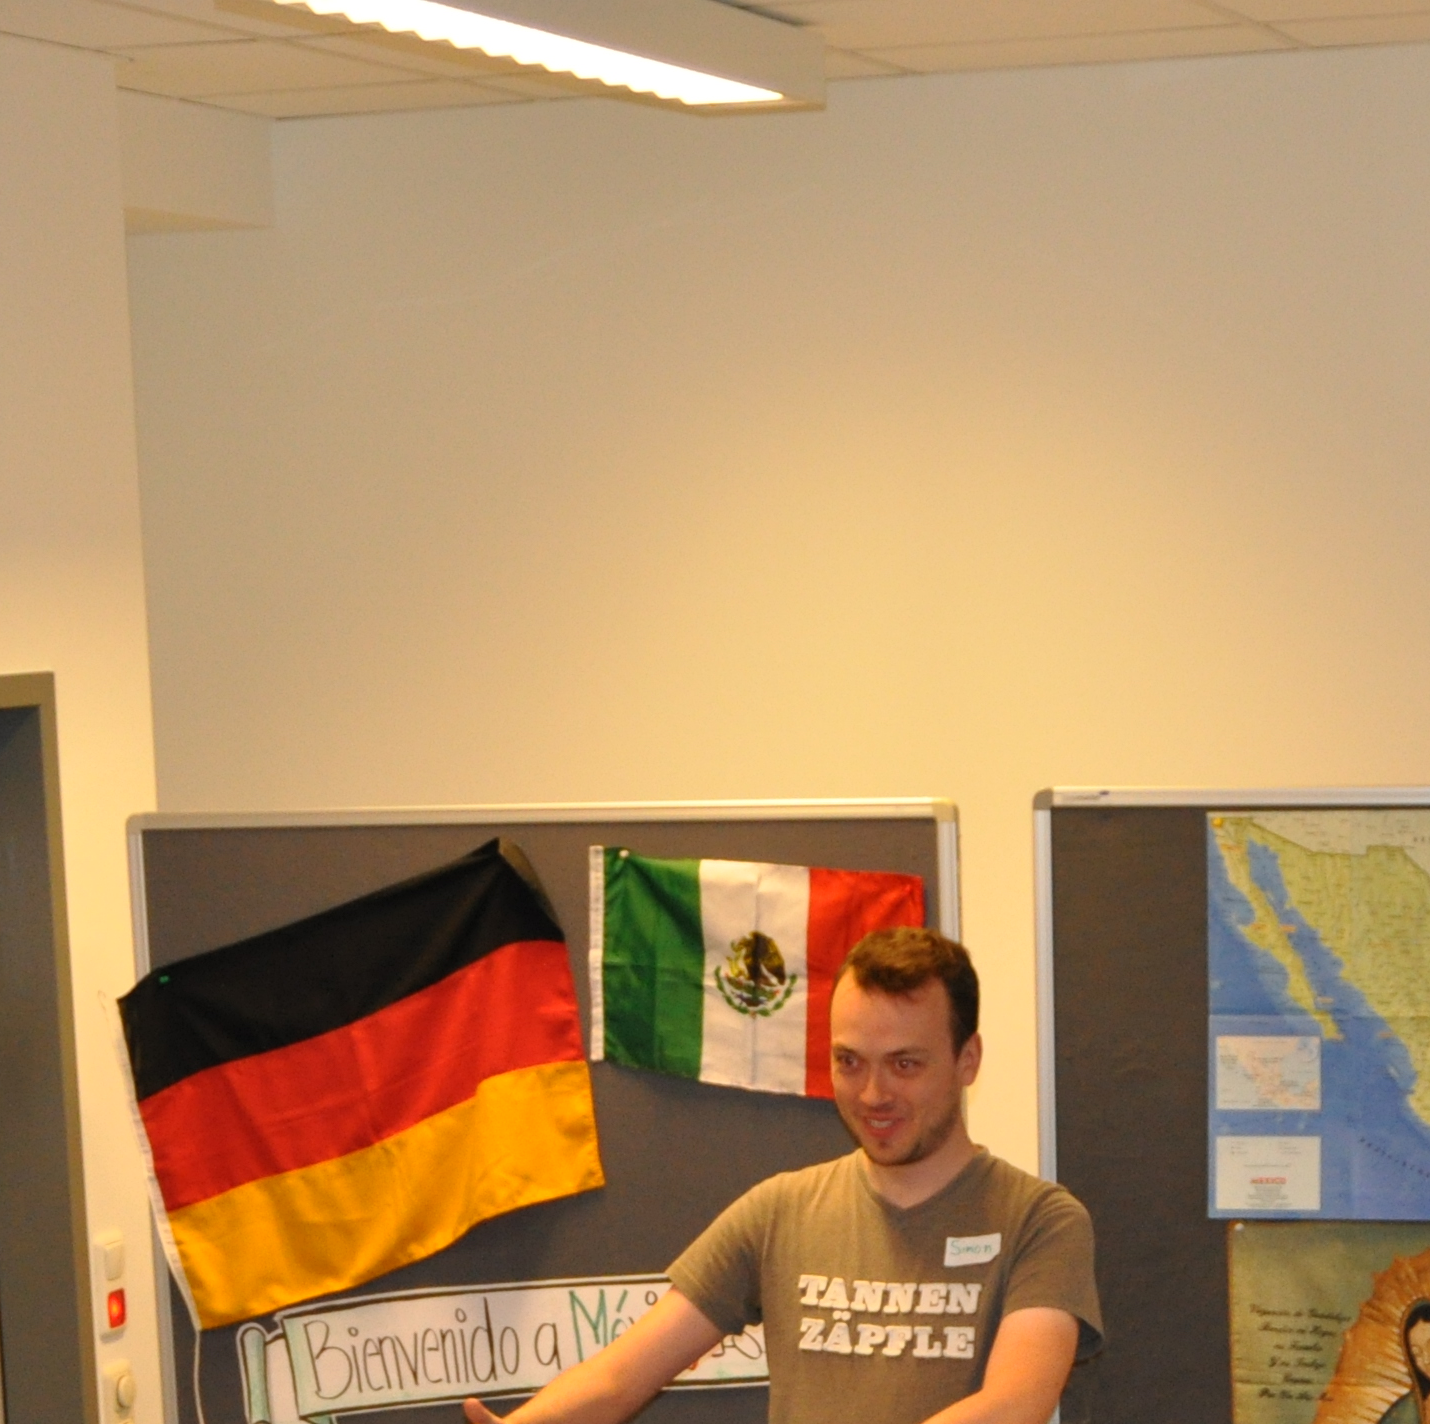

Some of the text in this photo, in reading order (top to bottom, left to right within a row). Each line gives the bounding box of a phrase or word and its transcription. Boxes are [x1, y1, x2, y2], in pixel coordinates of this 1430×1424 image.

[797, 1274, 983, 1315] TANNEN
[302, 1296, 520, 1401] Bienvenido
[534, 1321, 562, 1371] a
[797, 1309, 976, 1360] ZÄPFLE
